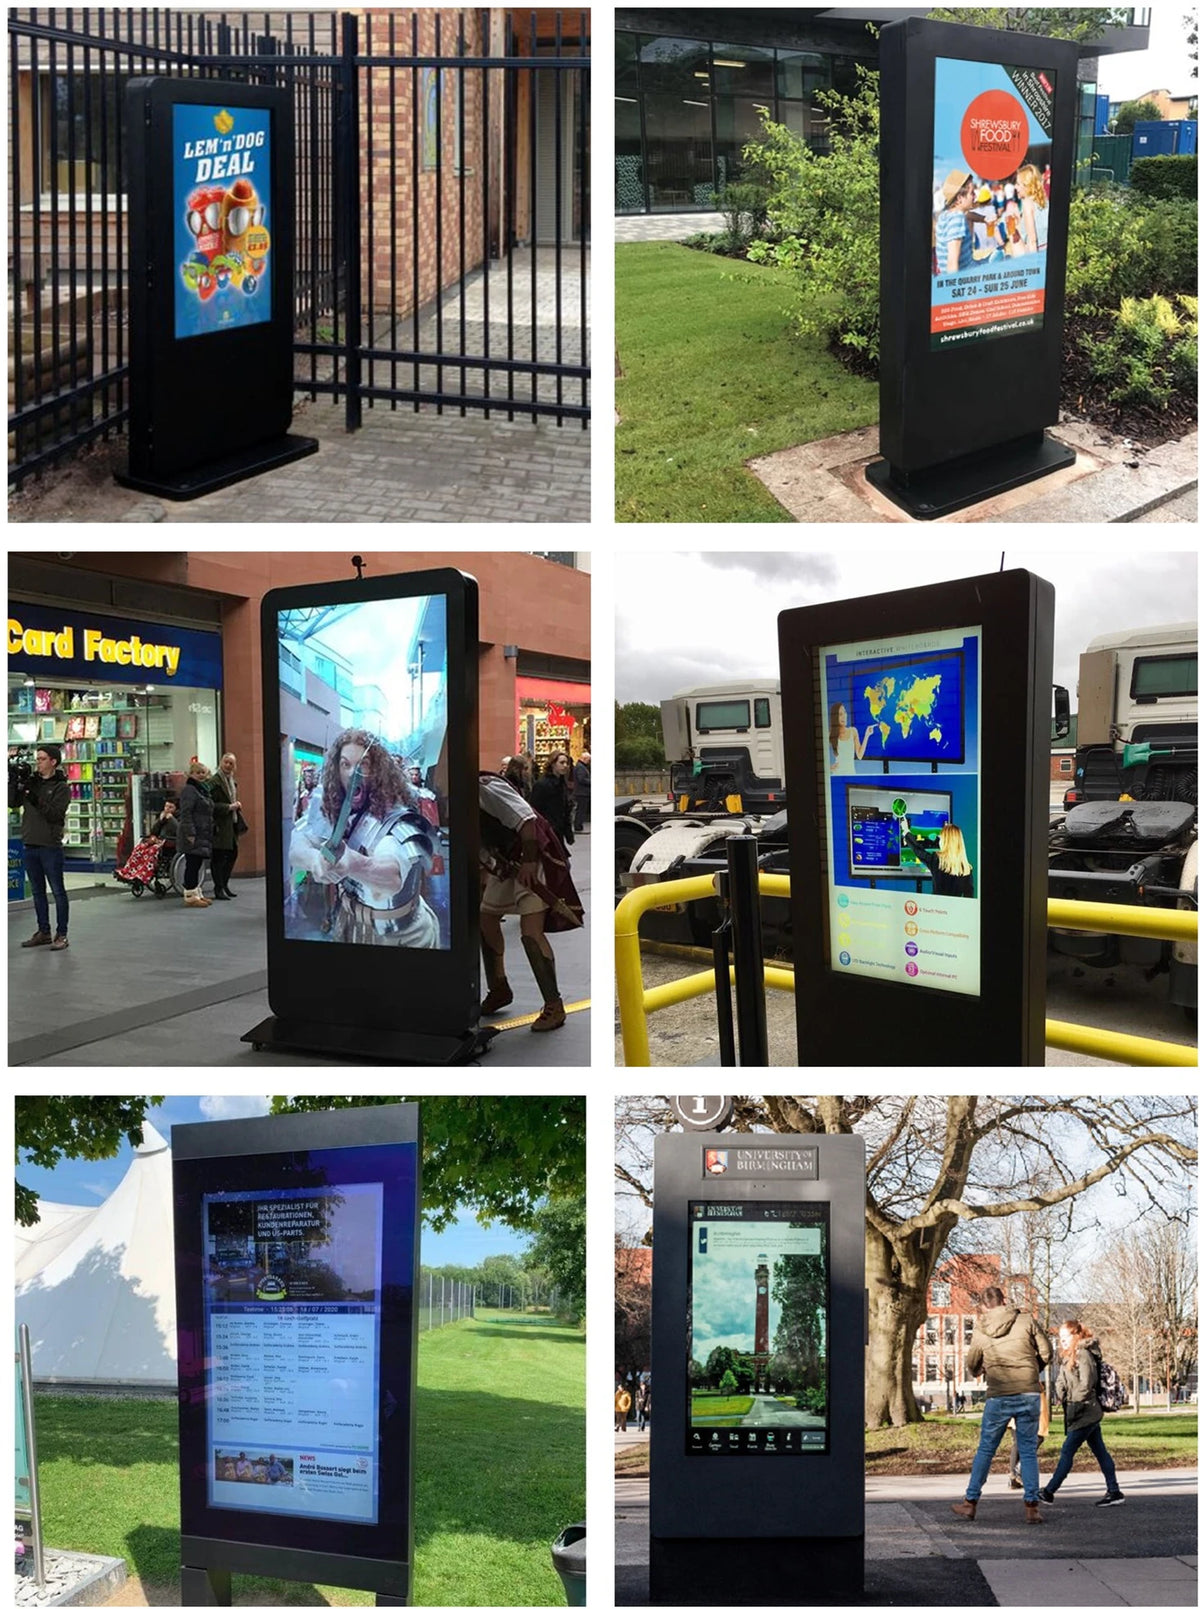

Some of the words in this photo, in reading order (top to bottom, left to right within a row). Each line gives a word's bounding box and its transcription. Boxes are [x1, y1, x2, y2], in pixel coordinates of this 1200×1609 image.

[1012, 70, 1038, 109] WINNER
[1035, 108, 1052, 129] 2017
[970, 118, 1022, 130] SHREWSBURY
[980, 129, 1013, 142] FOOD
[980, 142, 1011, 152] FESTIVAL
[195, 151, 256, 184] DEAL
[937, 279, 944, 288] IN
[945, 278, 957, 287] THE
[958, 275, 981, 286] QUARRY
[982, 273, 996, 282] PARK
[1003, 270, 1024, 279] AROUND
[1026, 267, 1040, 276] TOWN
[951, 288, 965, 298] SAT
[968, 286, 977, 296] 24
[984, 283, 998, 293] SUN
[1000, 281, 1009, 291] 25
[1011, 279, 1028, 289] JUNE
[940, 319, 1035, 343] shrewsburyfoodfestival.co.uk
[8, 618, 74, 659] Card
[83, 629, 181, 677] Factory
[856, 647, 894, 656] INTERACTIVE
[737, 1150, 802, 1160] UNIVERSITY
[737, 1161, 812, 1171] BIRMINGHAM
[257, 1204, 269, 1212] IHR
[269, 1203, 305, 1211] SPEZIALIST
[305, 1201, 319, 1210] FÜR
[257, 1219, 320, 1229] KUNDENREPARATUR
